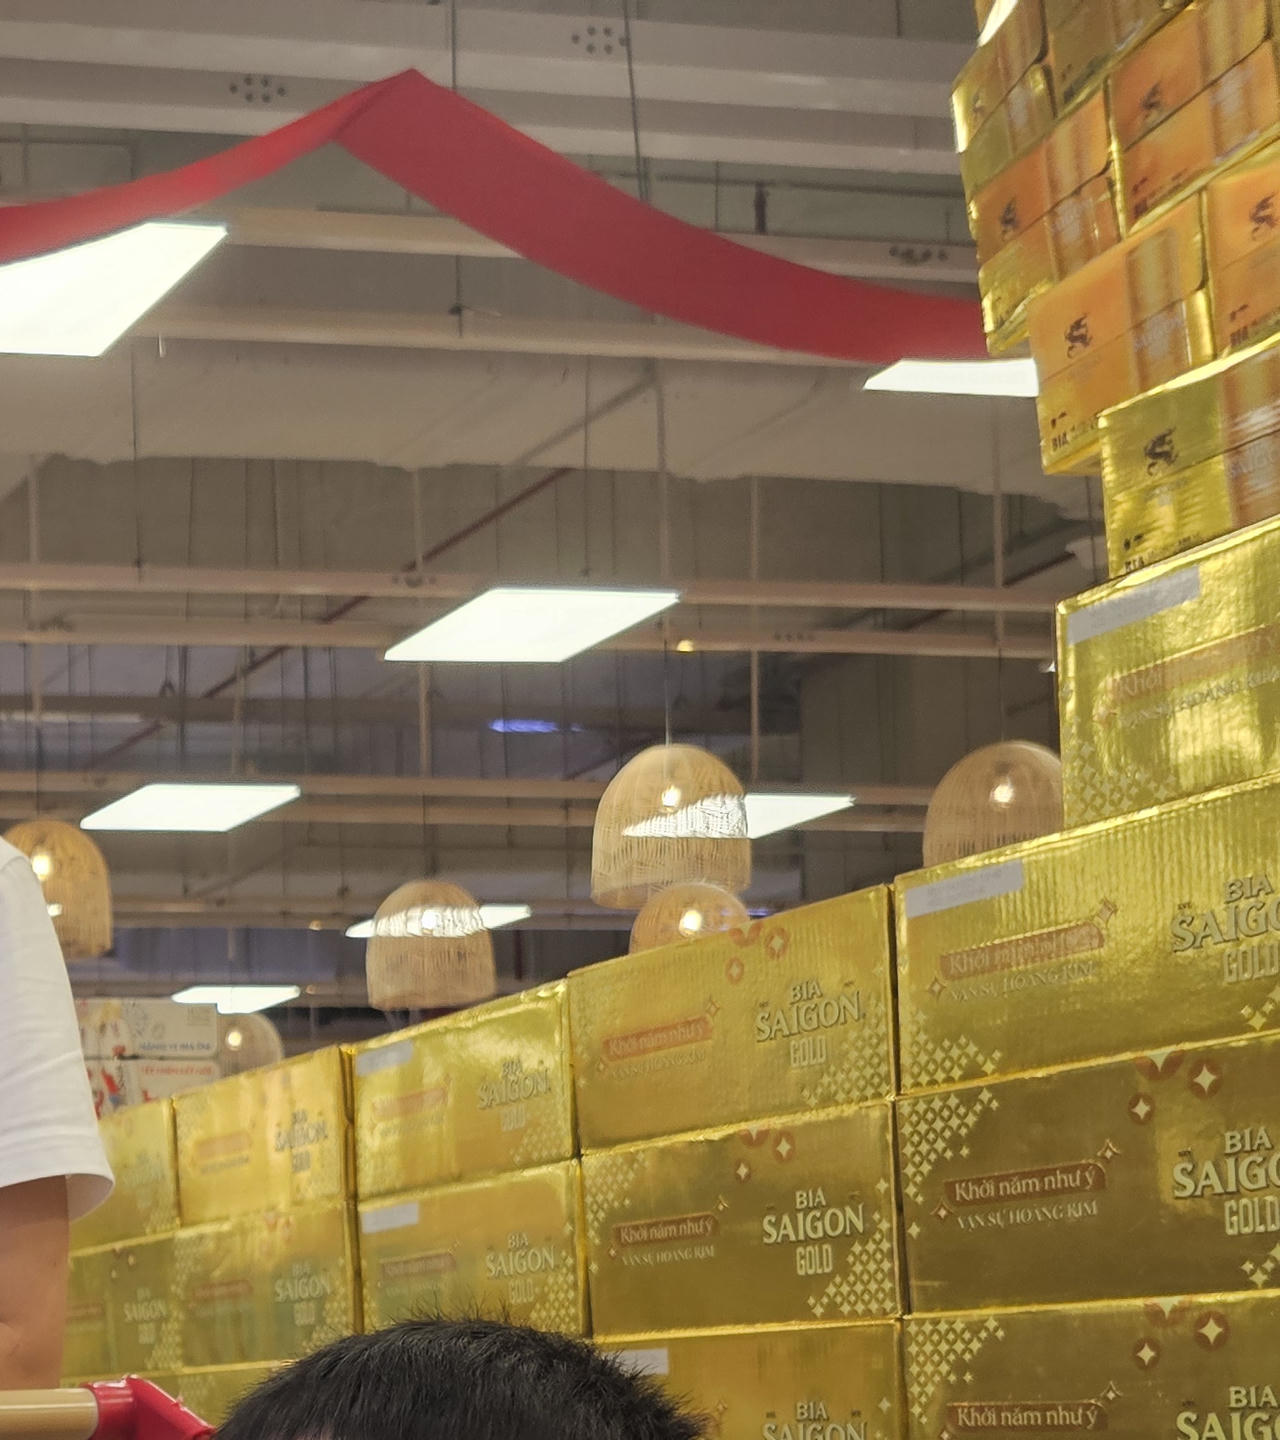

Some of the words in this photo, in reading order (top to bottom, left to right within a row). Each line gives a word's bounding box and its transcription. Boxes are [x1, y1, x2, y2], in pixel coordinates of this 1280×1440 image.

[1226, 875, 1275, 903] BIA
[791, 979, 823, 1006] BIA
[754, 992, 864, 1043] SAIGON
[1225, 1127, 1273, 1154] BIA
[796, 1188, 827, 1211] BIA
[954, 1176, 996, 1202] Khởi
[999, 1176, 1040, 1198] năm
[762, 1203, 865, 1247] SAIGON
[1224, 1196, 1280, 1236] GOLD
[485, 1246, 556, 1279] SAIGON
[796, 1244, 834, 1276] GOLD
[1229, 1386, 1277, 1409] BIA
[796, 1401, 828, 1422] BIA
[957, 1405, 997, 1427] Khởi
[1000, 1406, 1041, 1427] năm
